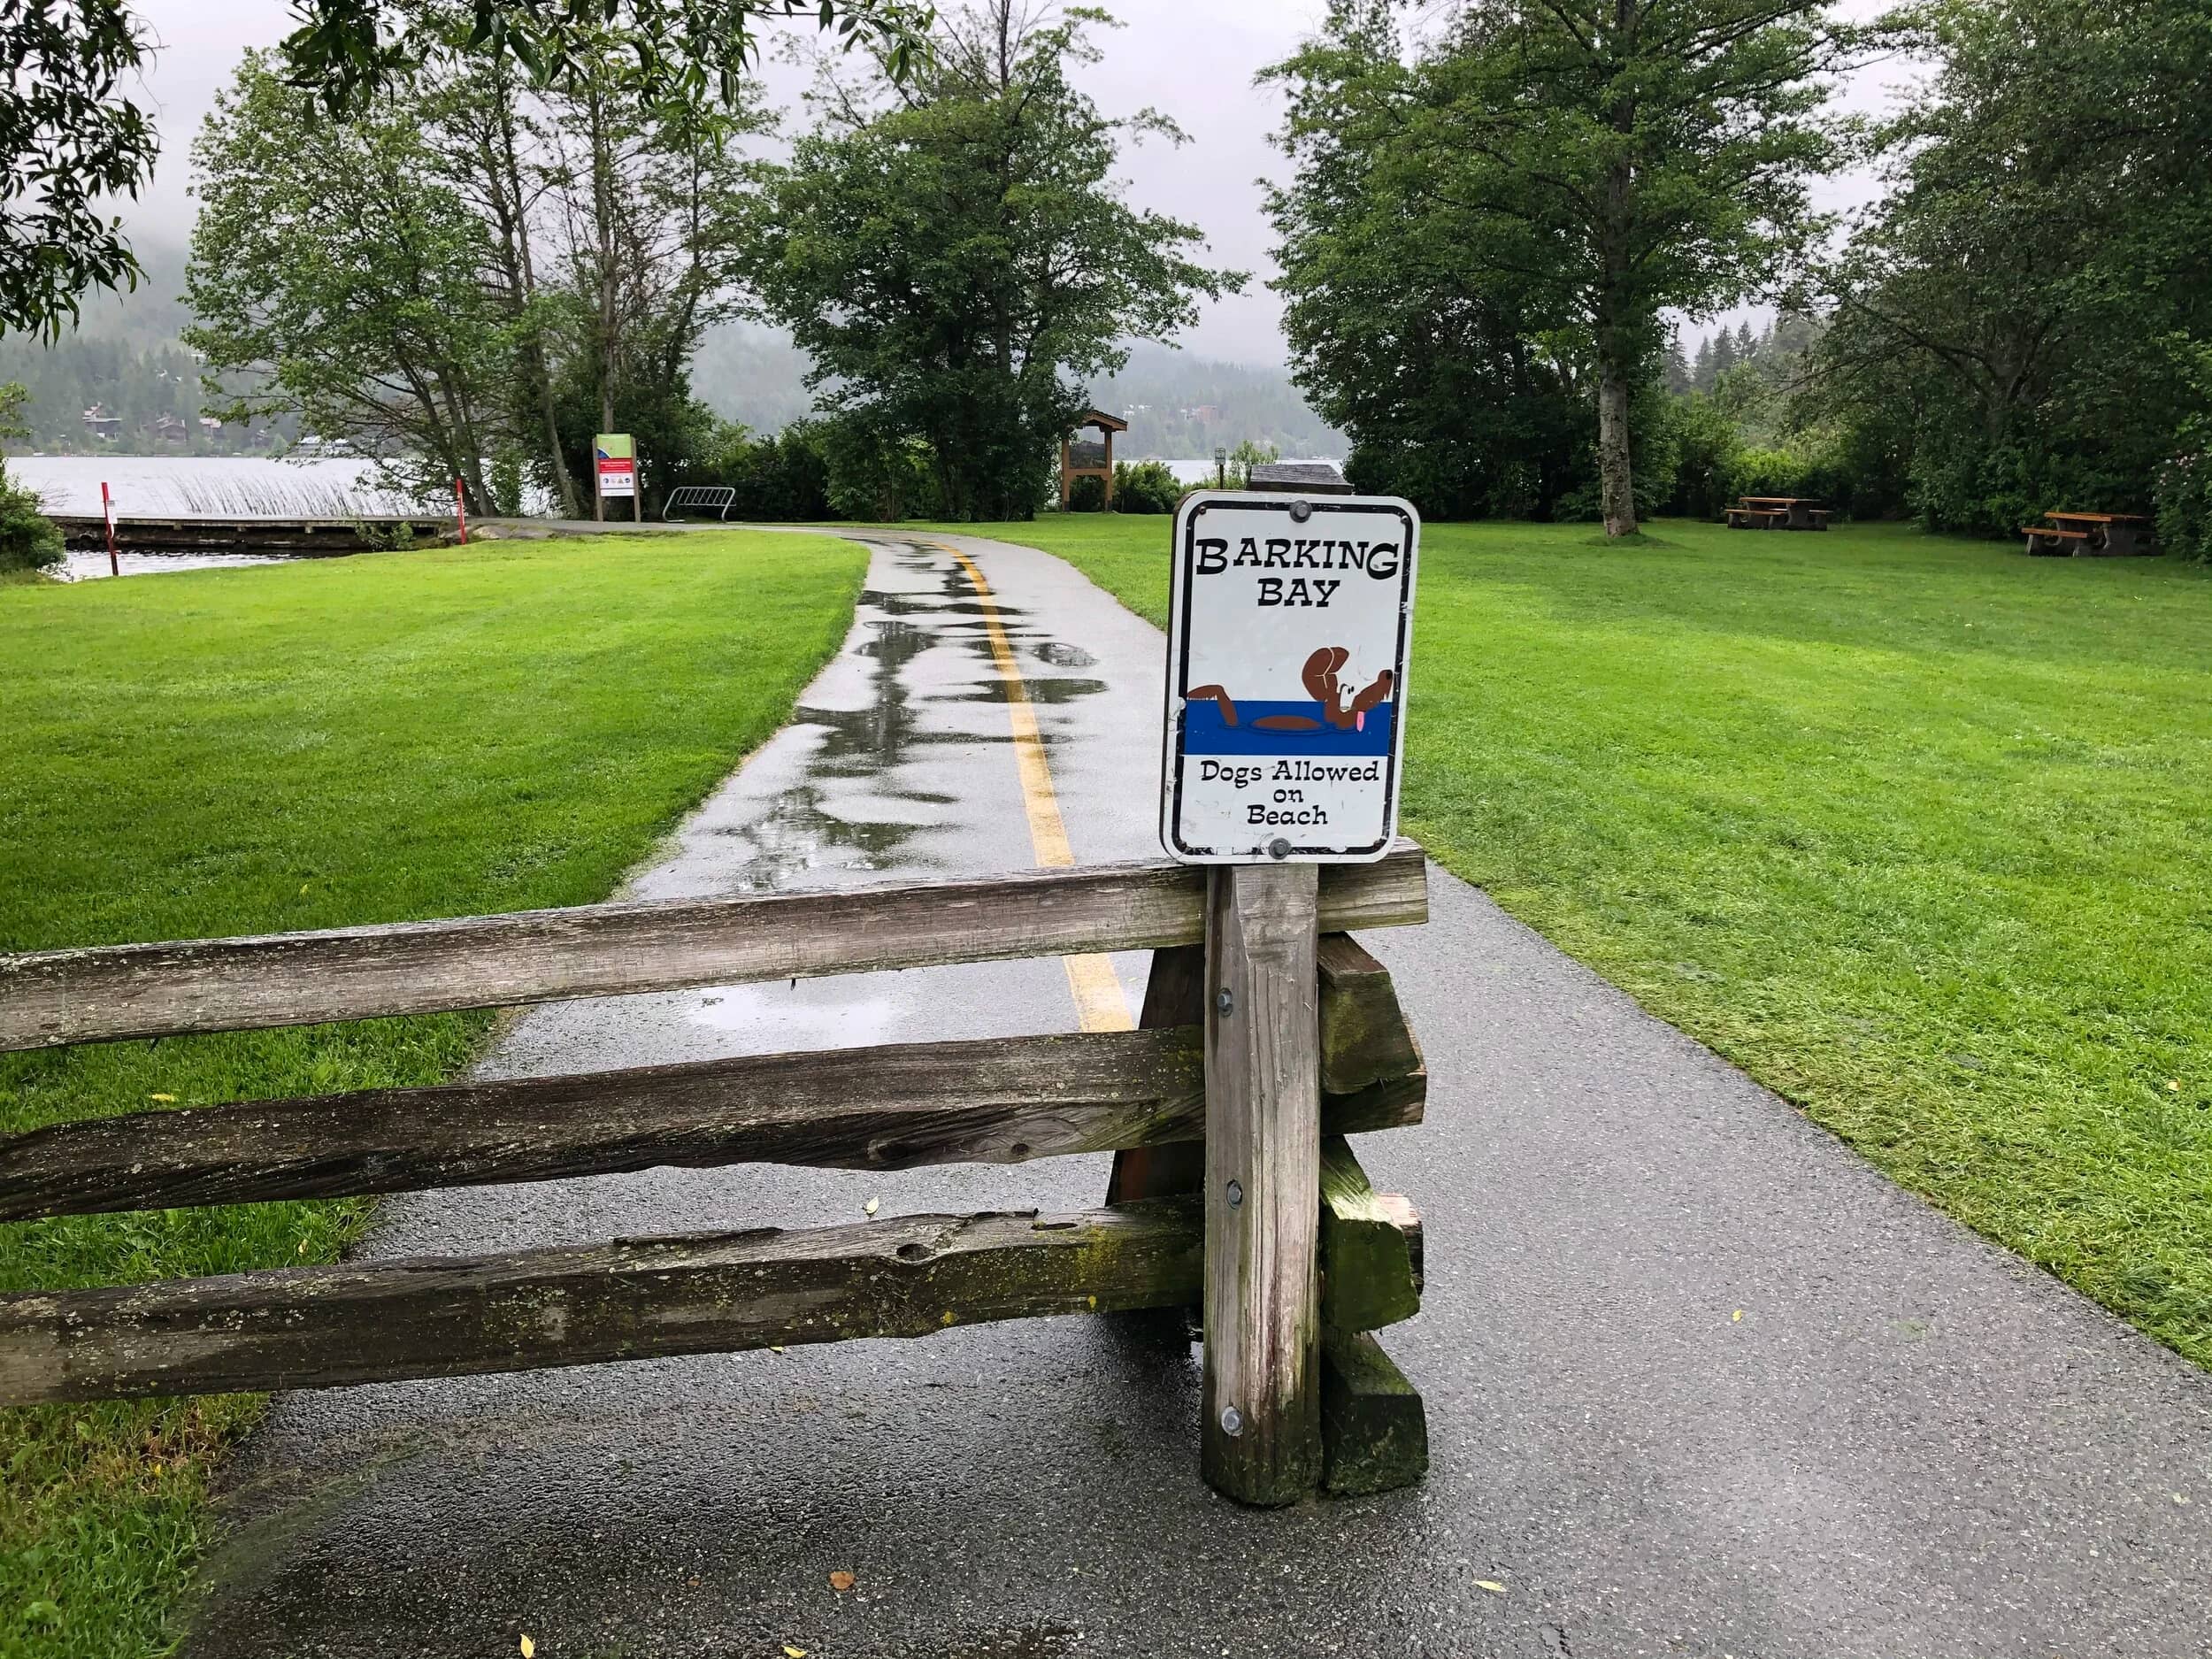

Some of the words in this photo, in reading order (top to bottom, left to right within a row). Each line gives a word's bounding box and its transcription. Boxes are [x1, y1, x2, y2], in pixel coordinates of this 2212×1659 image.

[1195, 538, 1399, 580] BARKING
[1257, 578, 1340, 607] BAY
[1201, 760, 1262, 788] Dogs
[1271, 761, 1379, 781] Allowed
[1274, 789, 1303, 803] on
[1248, 804, 1327, 825] Beach
